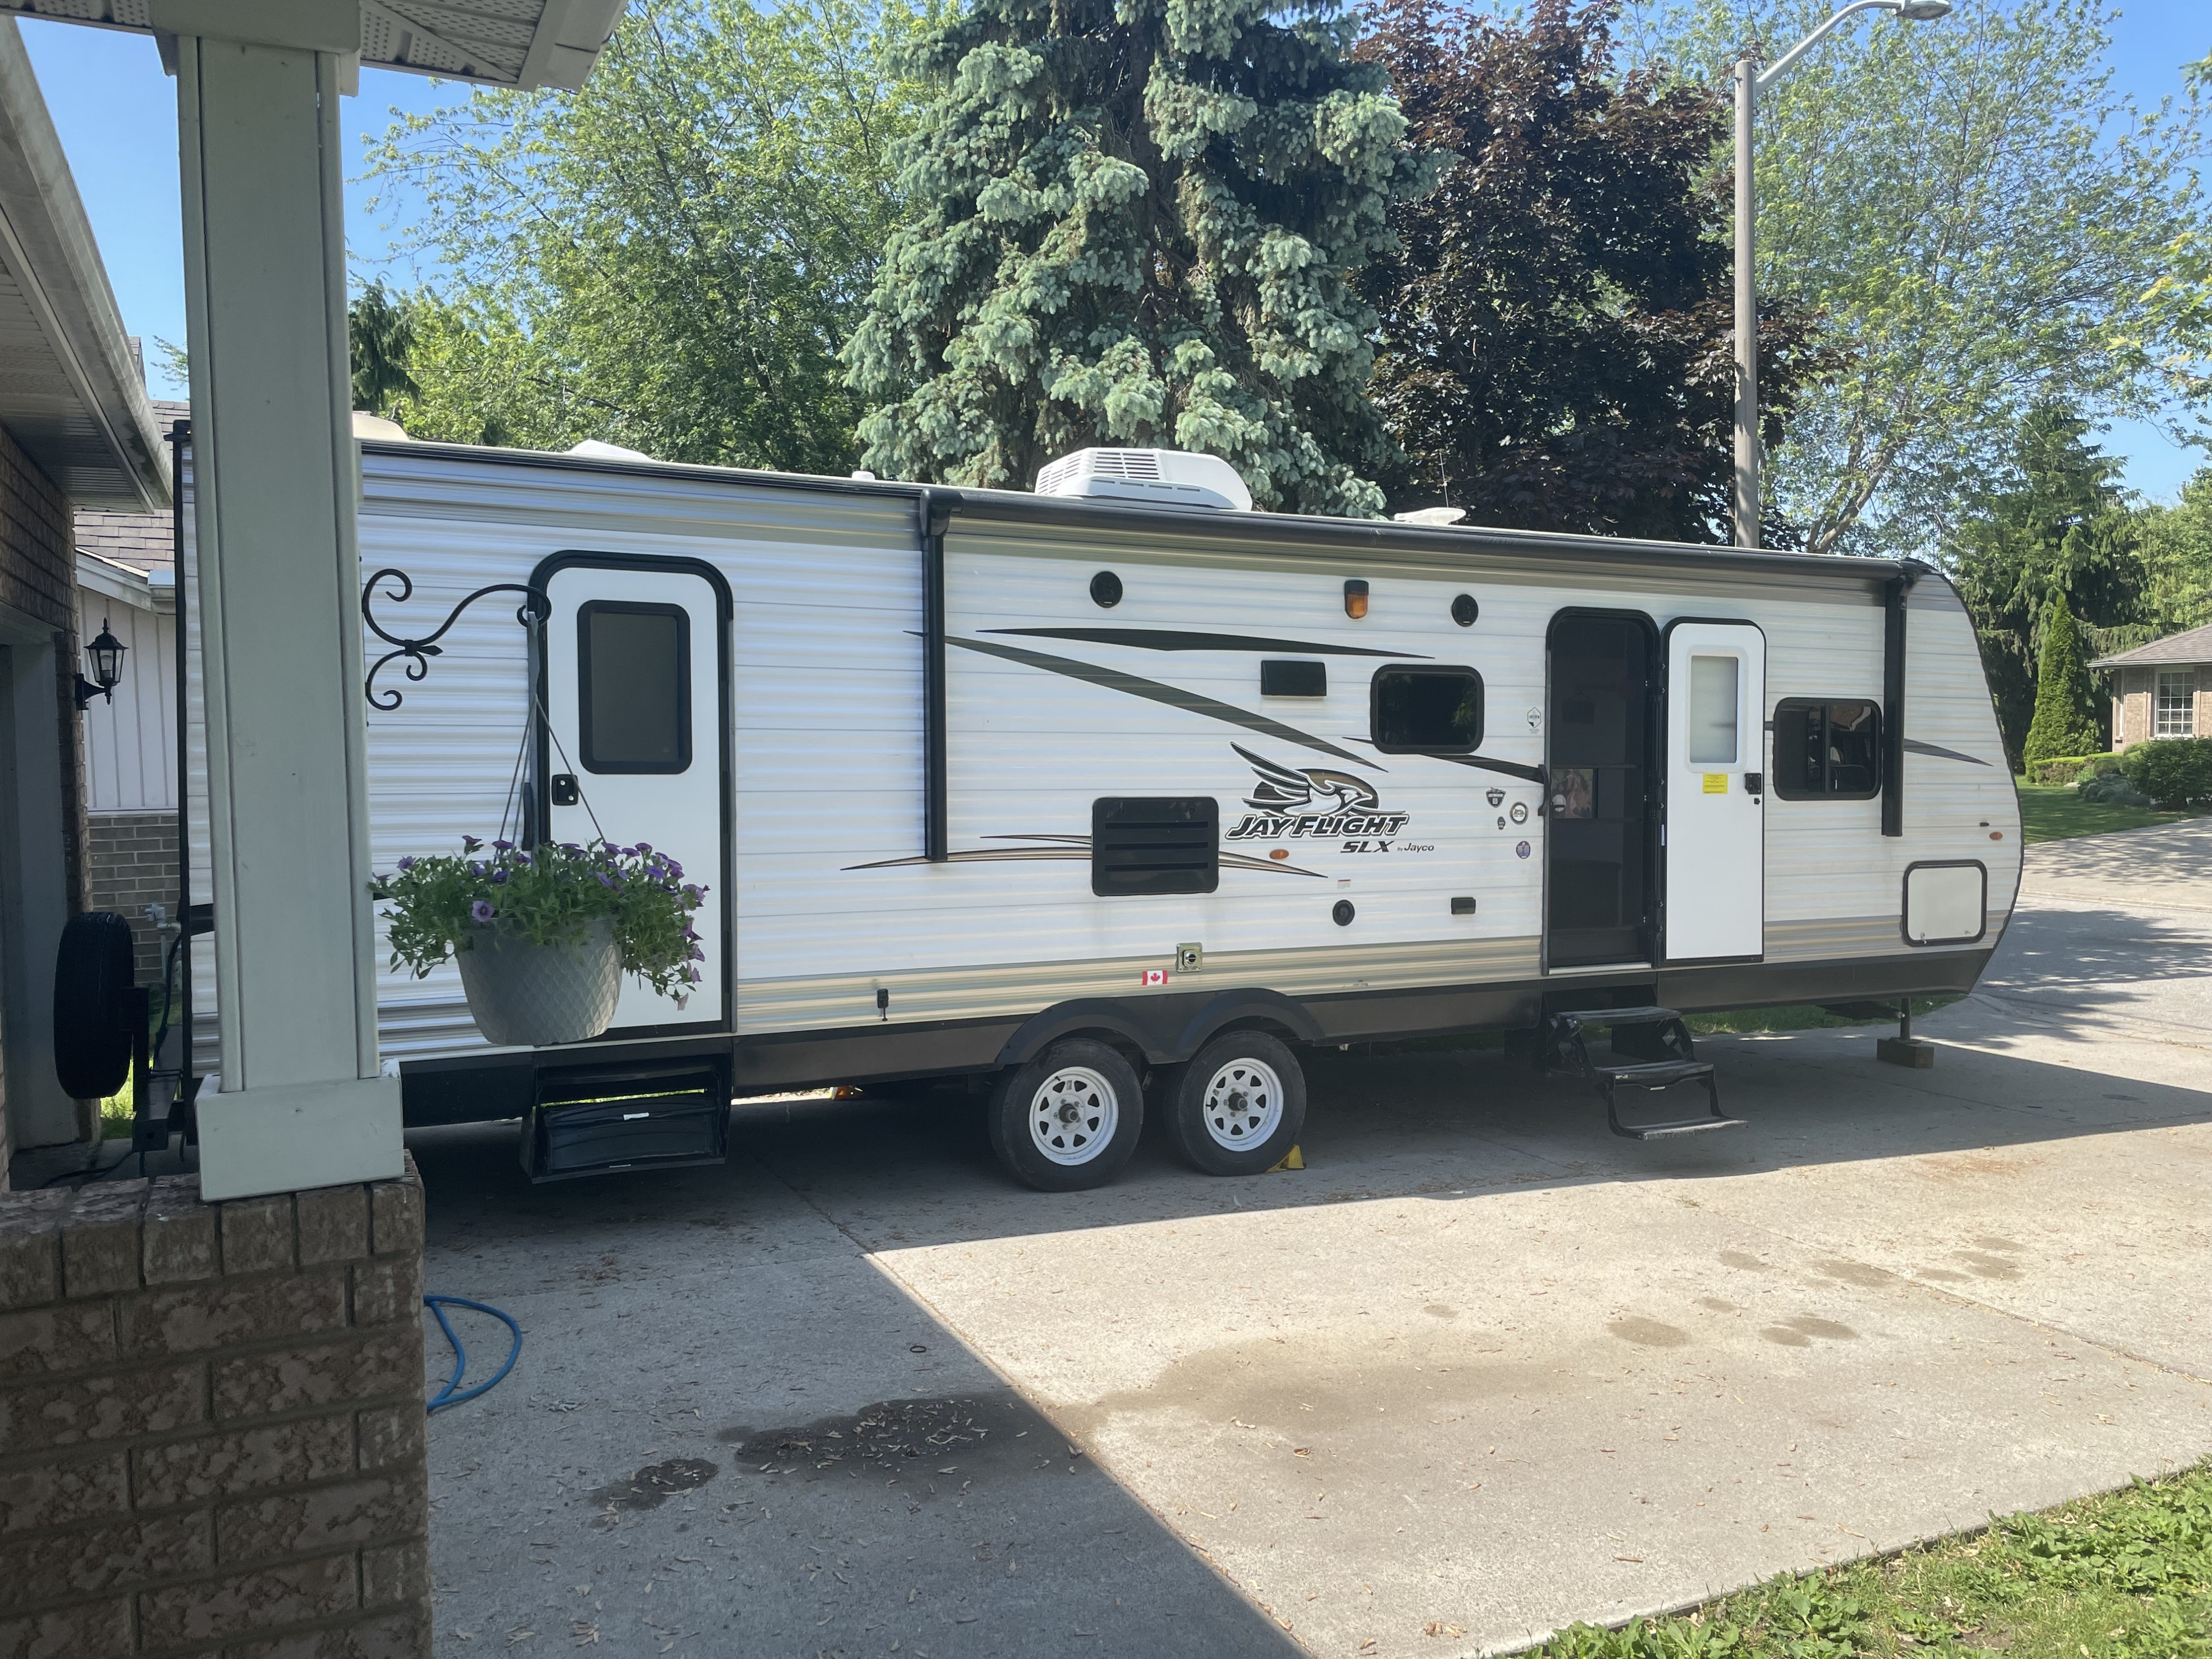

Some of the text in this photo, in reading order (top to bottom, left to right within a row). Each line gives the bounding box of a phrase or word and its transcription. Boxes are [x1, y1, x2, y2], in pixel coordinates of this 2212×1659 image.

[1226, 814, 1409, 839] JAY FLIGHT
[1340, 841, 1395, 853] SLX
[1404, 843, 1434, 853] Jayco
